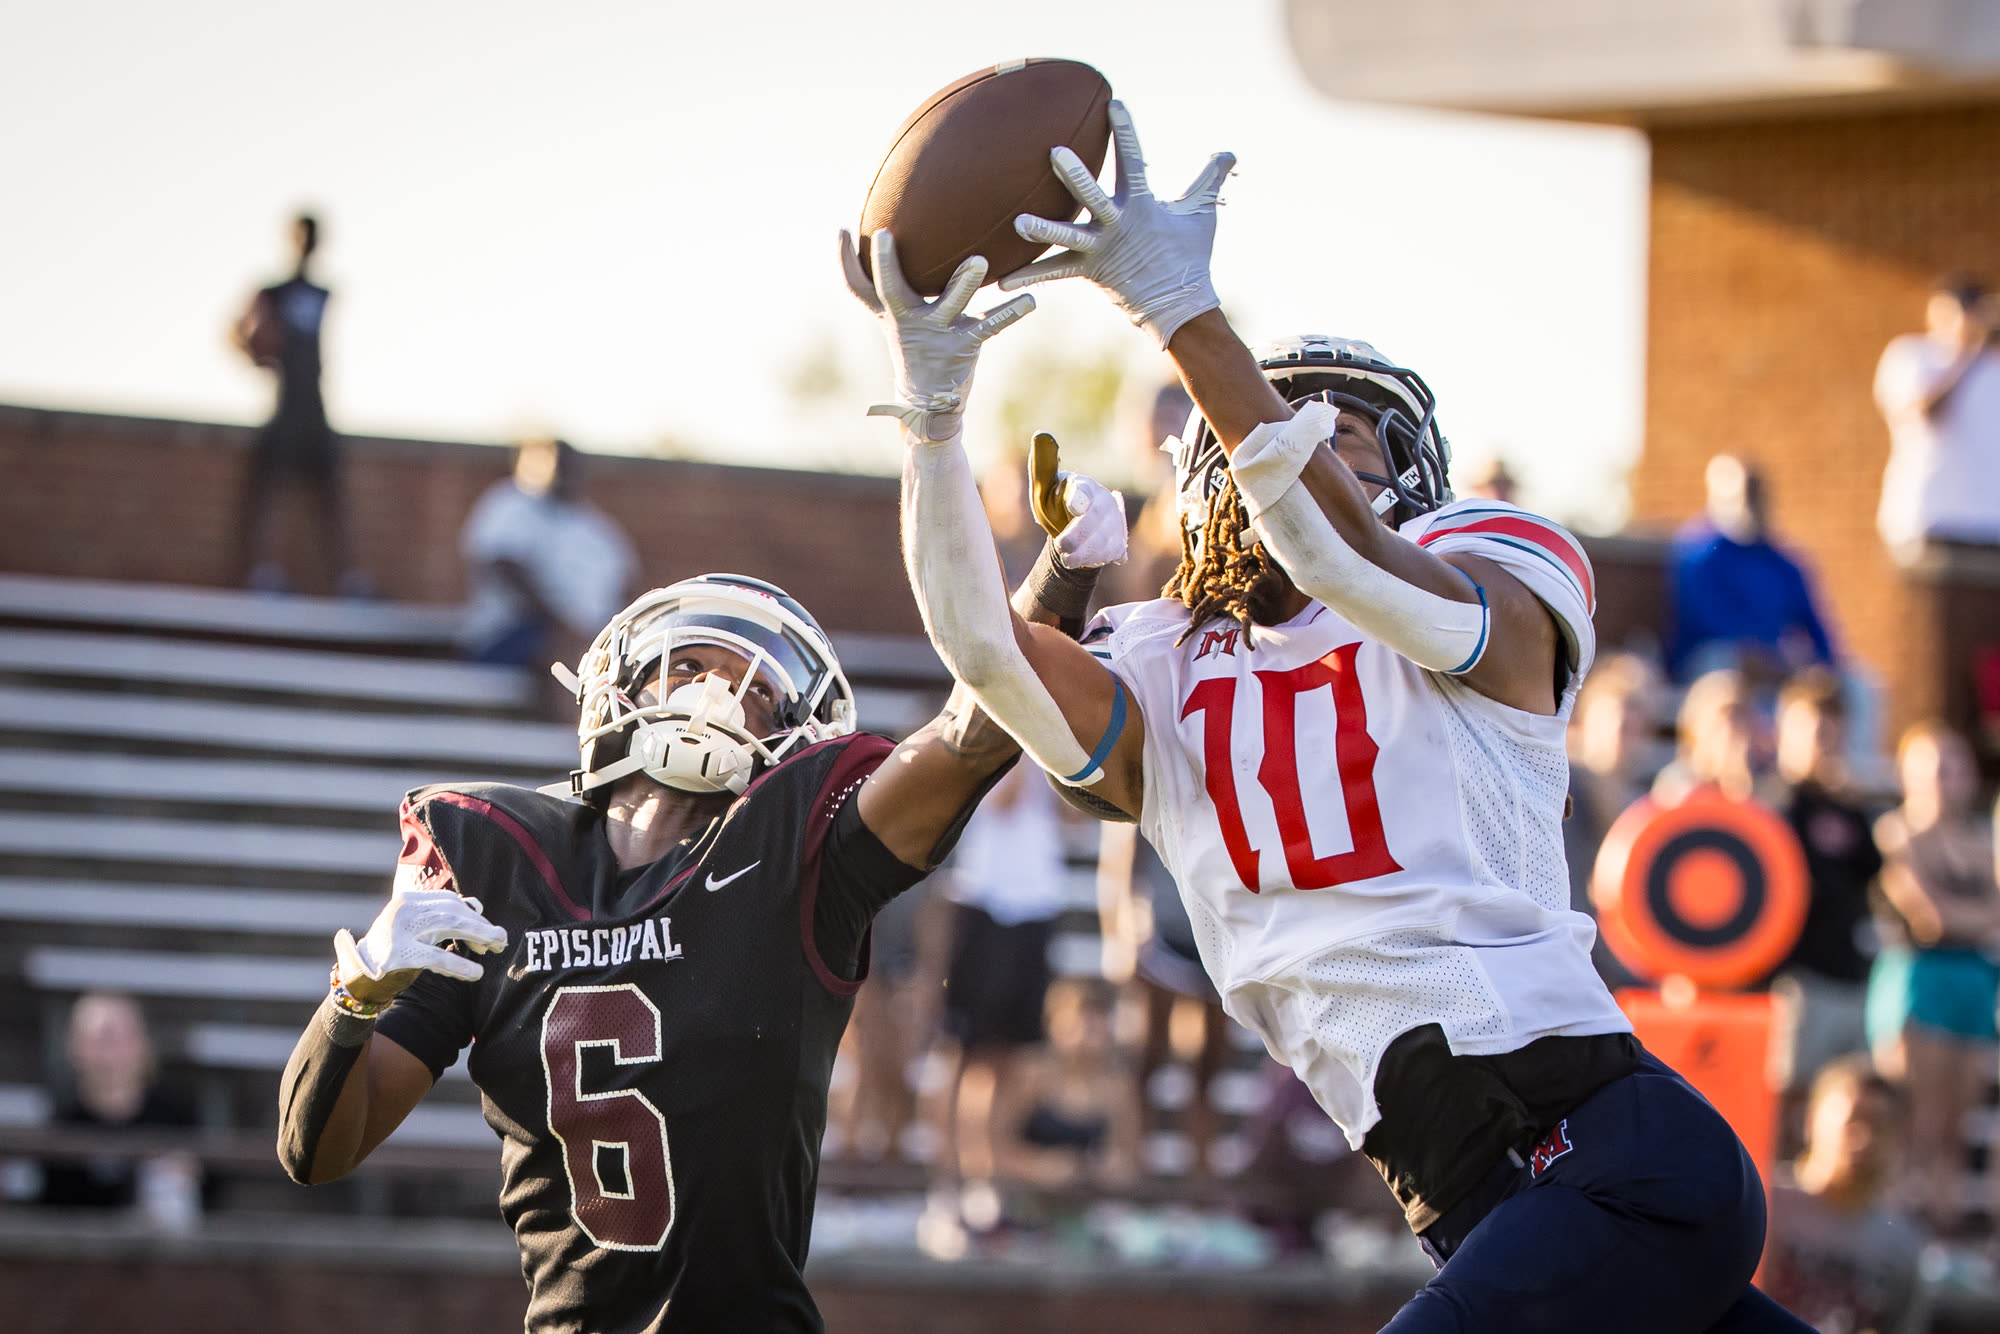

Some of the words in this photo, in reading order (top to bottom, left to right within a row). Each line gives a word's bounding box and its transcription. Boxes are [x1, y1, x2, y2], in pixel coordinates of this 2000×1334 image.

[1192, 628, 1242, 662] M
[1181, 641, 1405, 894] 10
[525, 917, 683, 973] EPISCOPAL
[540, 983, 675, 1252] 6
